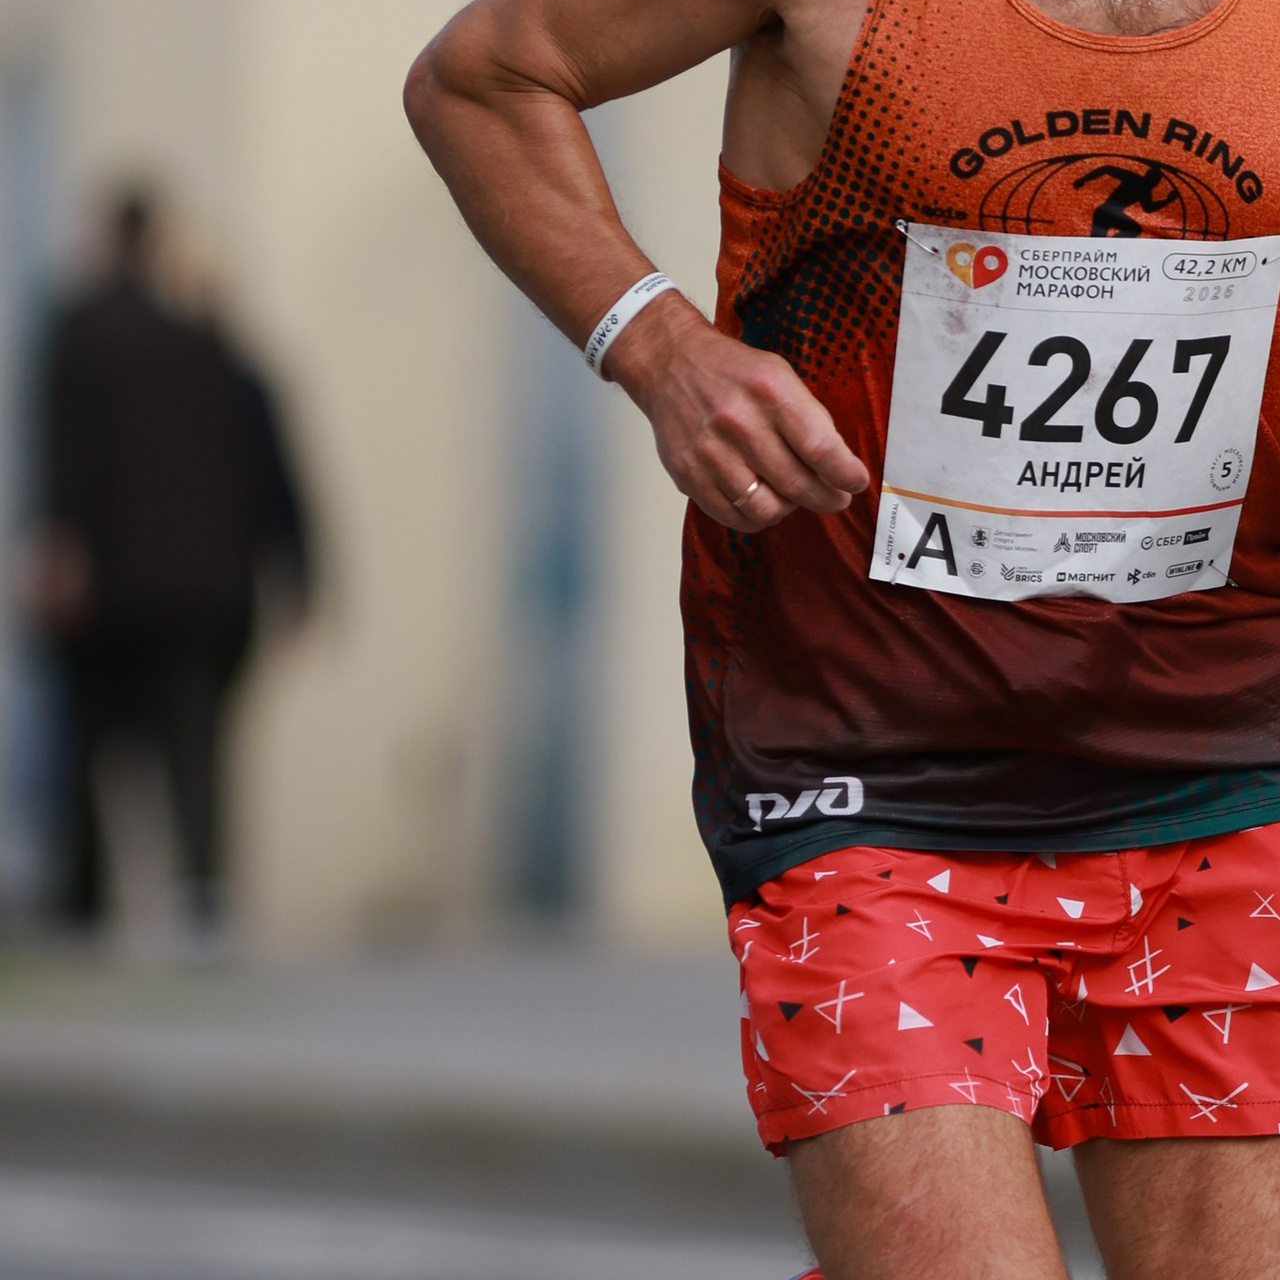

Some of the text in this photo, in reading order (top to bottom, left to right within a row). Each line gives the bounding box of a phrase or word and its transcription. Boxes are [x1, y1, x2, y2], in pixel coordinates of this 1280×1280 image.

[950, 109, 1263, 204] GOLDEN RING
[1020, 248, 1118, 263] СБЕРПРАЙМ
[1018, 264, 1151, 283] МОСКОВСКИЙ
[1173, 258, 1216, 278] 42,2
[1016, 282, 1115, 300] МАРАФОН
[940, 330, 1232, 445] 4267
[1017, 456, 1146, 493] АНДРЕЙ
[1220, 461, 1233, 479] 5
[1074, 530, 1127, 544] МОСКОВСКИЙ
[1155, 535, 1183, 548] СБЕР
[885, 534, 895, 566] КЛАСТЕР
[1073, 543, 1099, 554] СПОРТ
[1015, 574, 1043, 583] BRICS
